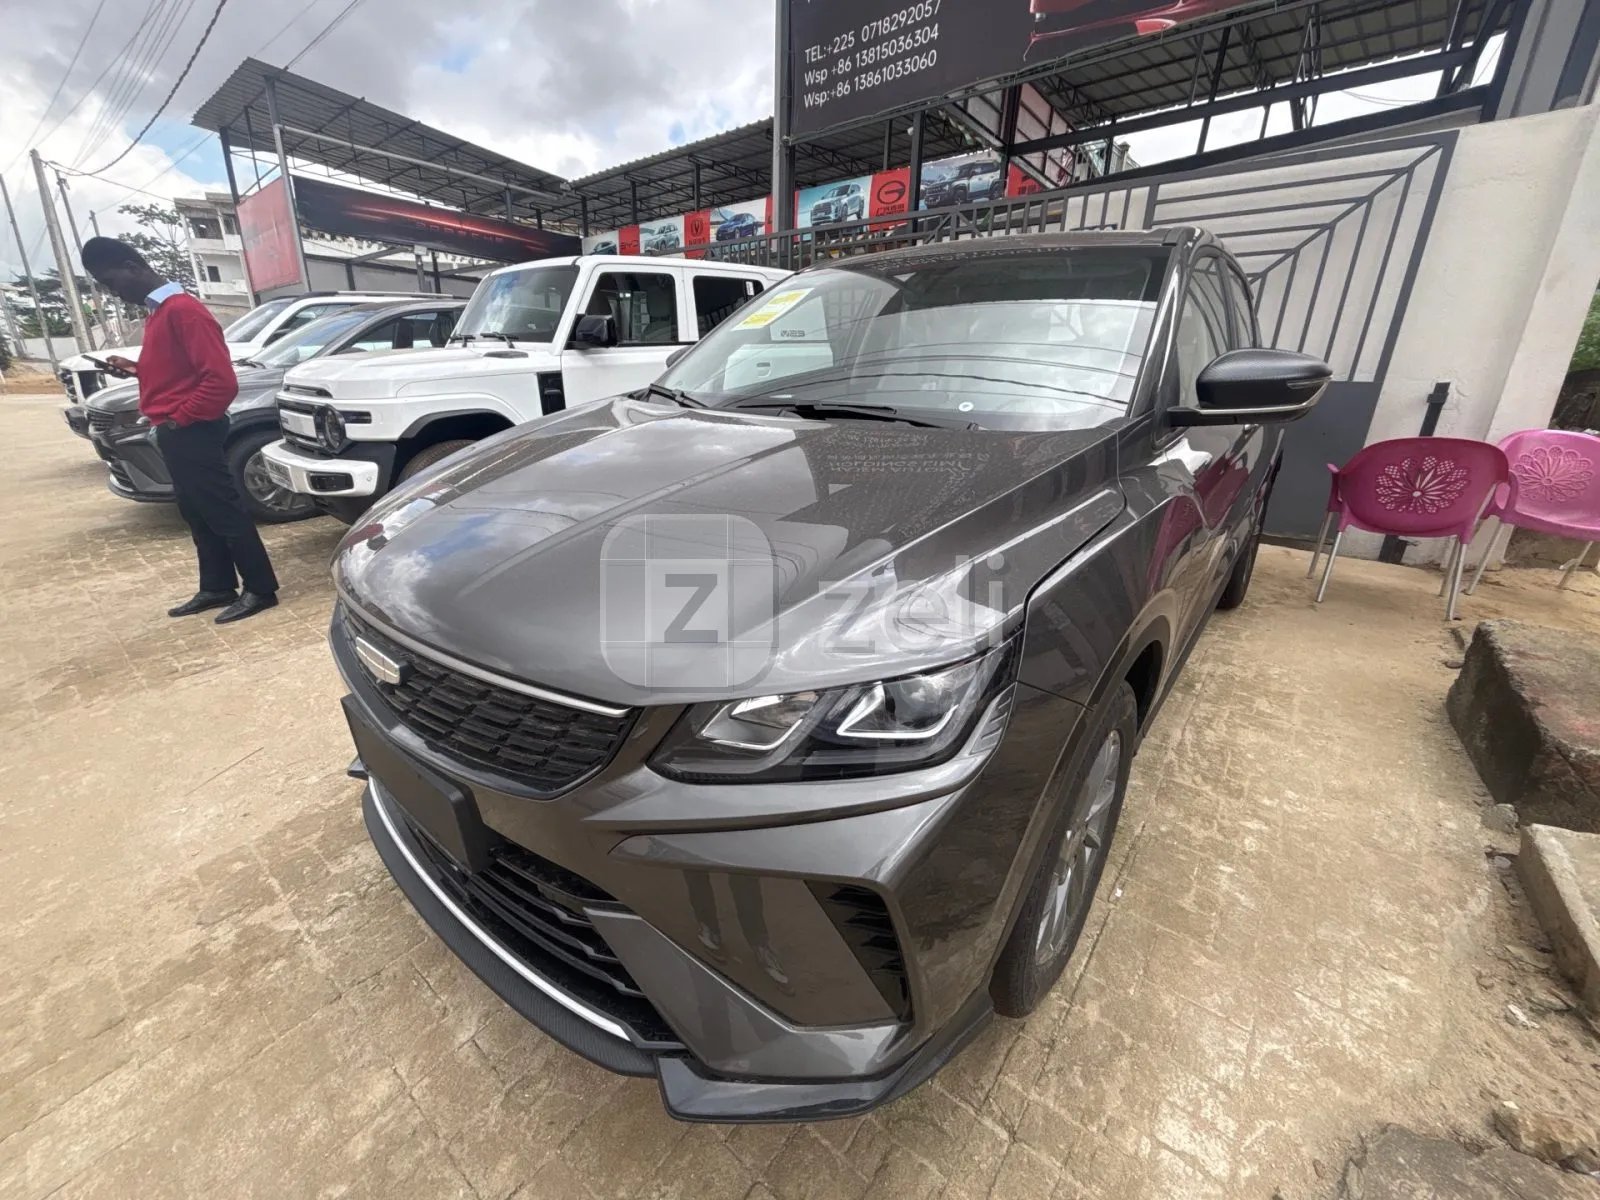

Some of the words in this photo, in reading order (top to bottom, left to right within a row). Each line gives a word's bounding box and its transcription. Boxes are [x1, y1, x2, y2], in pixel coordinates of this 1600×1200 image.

[805, 31, 855, 64] TEL:+225
[805, 69, 828, 87] Wsp
[831, 56, 852, 75] +86
[856, 23, 939, 68] 13815036304
[854, 50, 937, 91] 13861033060
